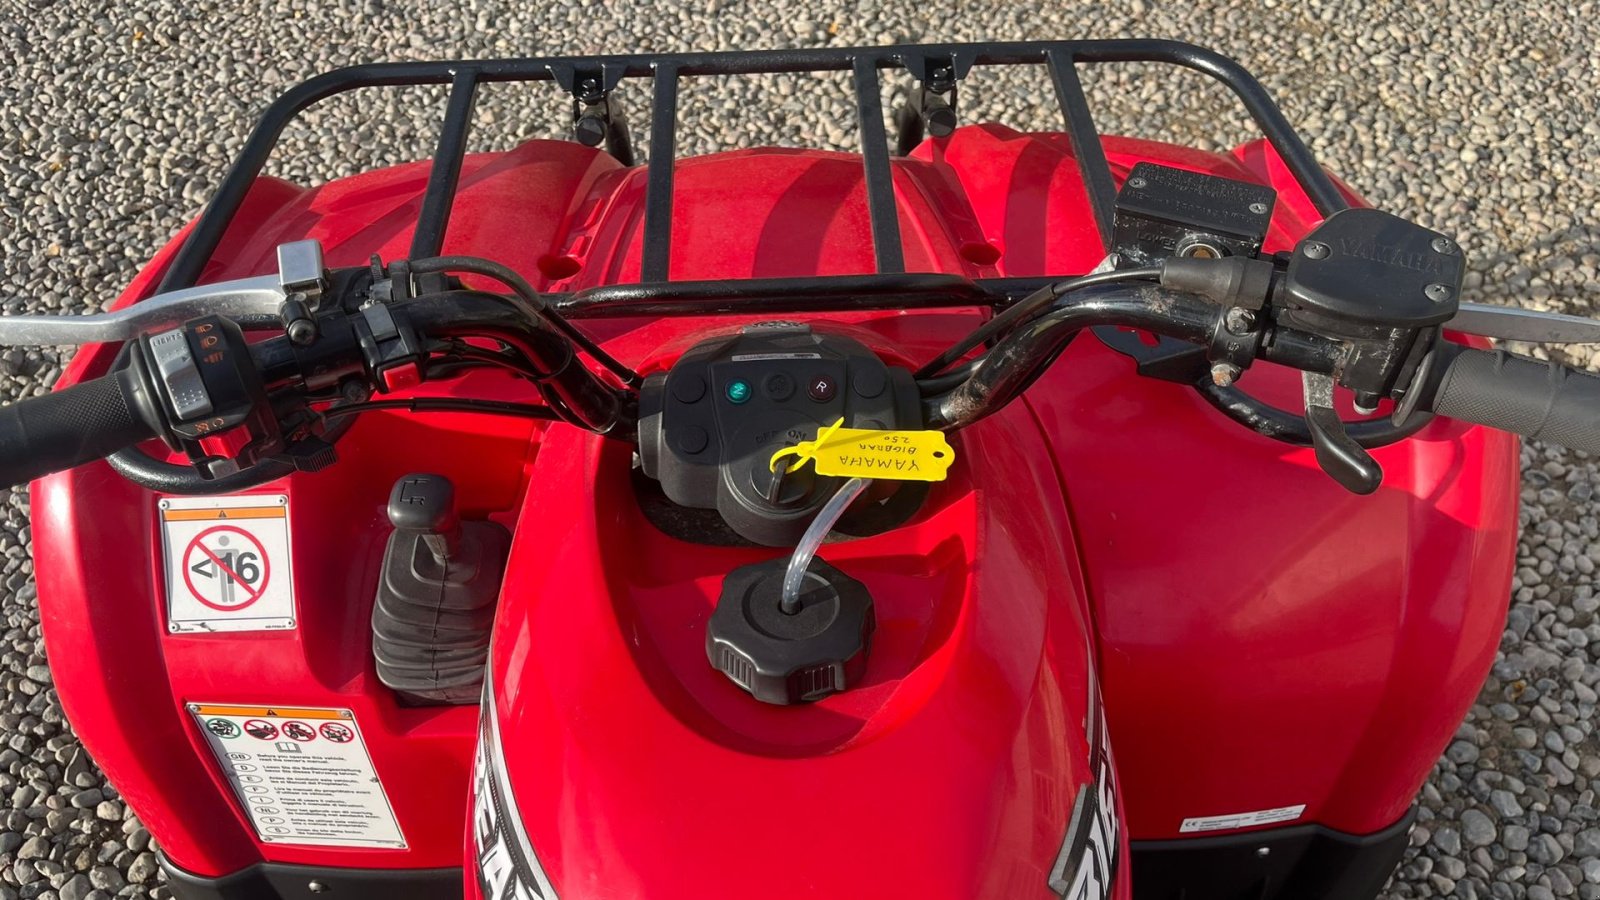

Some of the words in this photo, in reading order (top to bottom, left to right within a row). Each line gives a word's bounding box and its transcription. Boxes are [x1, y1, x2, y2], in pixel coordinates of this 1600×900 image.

[1341, 238, 1440, 274] YAMAHA
[152, 333, 182, 347] LIGHTS
[815, 380, 828, 393] R
[839, 455, 919, 472] YAMAHA
[230, 752, 246, 760] GB
